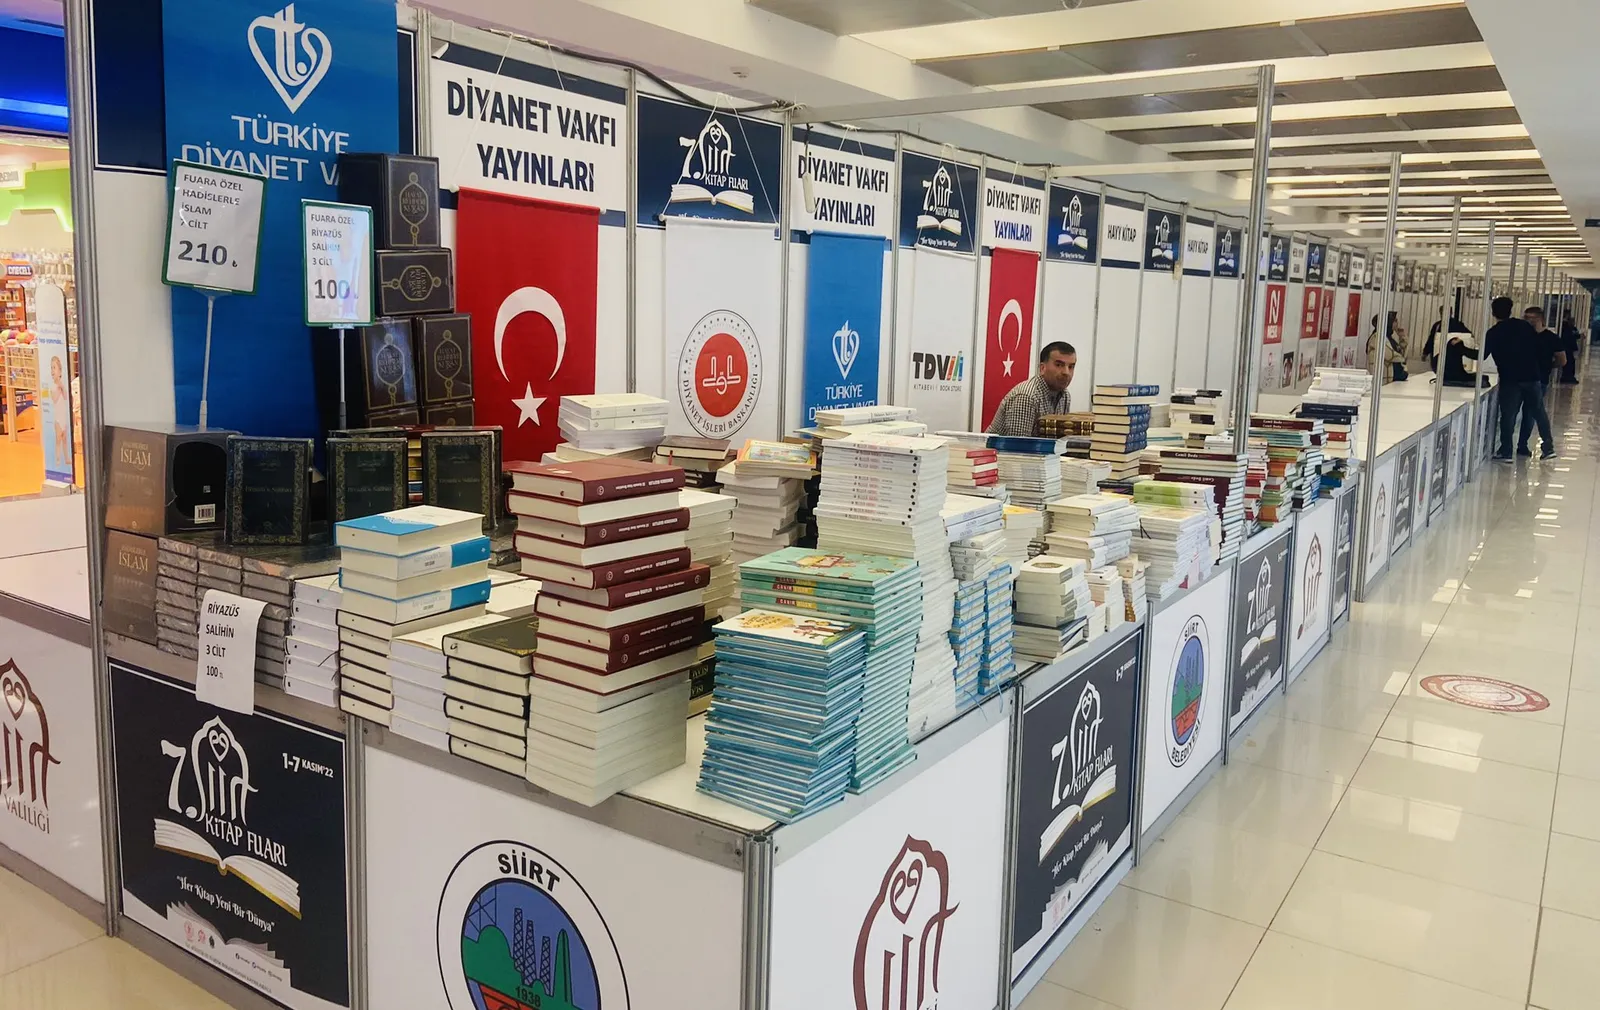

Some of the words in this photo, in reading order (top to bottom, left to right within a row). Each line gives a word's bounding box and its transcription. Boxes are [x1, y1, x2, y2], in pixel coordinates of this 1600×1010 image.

[447, 77, 551, 133] DİYANET
[557, 105, 616, 147] VAKFI
[231, 113, 349, 154] TÜRKİYE
[476, 144, 594, 192] YAYINLARI
[183, 174, 217, 187] FUARA
[219, 178, 243, 191] ÖZEL
[855, 167, 888, 194] VAKFI
[181, 202, 212, 215] İSLAM
[986, 185, 1019, 211] DİYANET
[1020, 195, 1041, 215] VAKFI
[311, 213, 336, 224] FUARA
[813, 197, 874, 227] YAYINLARI
[188, 219, 208, 230] CİLT
[311, 227, 342, 238] RİYAZÜS
[994, 219, 1032, 242] YAYINLARI
[178, 240, 228, 266] 210
[312, 257, 317, 265] 3
[318, 256, 333, 265] CİLT
[314, 279, 350, 299] 100
[825, 383, 863, 400] TÜRKİYE
[683, 379, 703, 425] DİYANET
[702, 419, 727, 433] İŞLERİ
[207, 601, 240, 617] RİYAZÜS
[205, 624, 234, 638] SALİHİN
[206, 644, 211, 655] 3
[212, 643, 226, 657] CİLT
[206, 665, 219, 677] 100
[282, 752, 300, 772] 1-7
[4, 793, 50, 834] VALİLİĞİ
[247, 830, 288, 867] FUARI
[515, 986, 541, 1008] 1938
